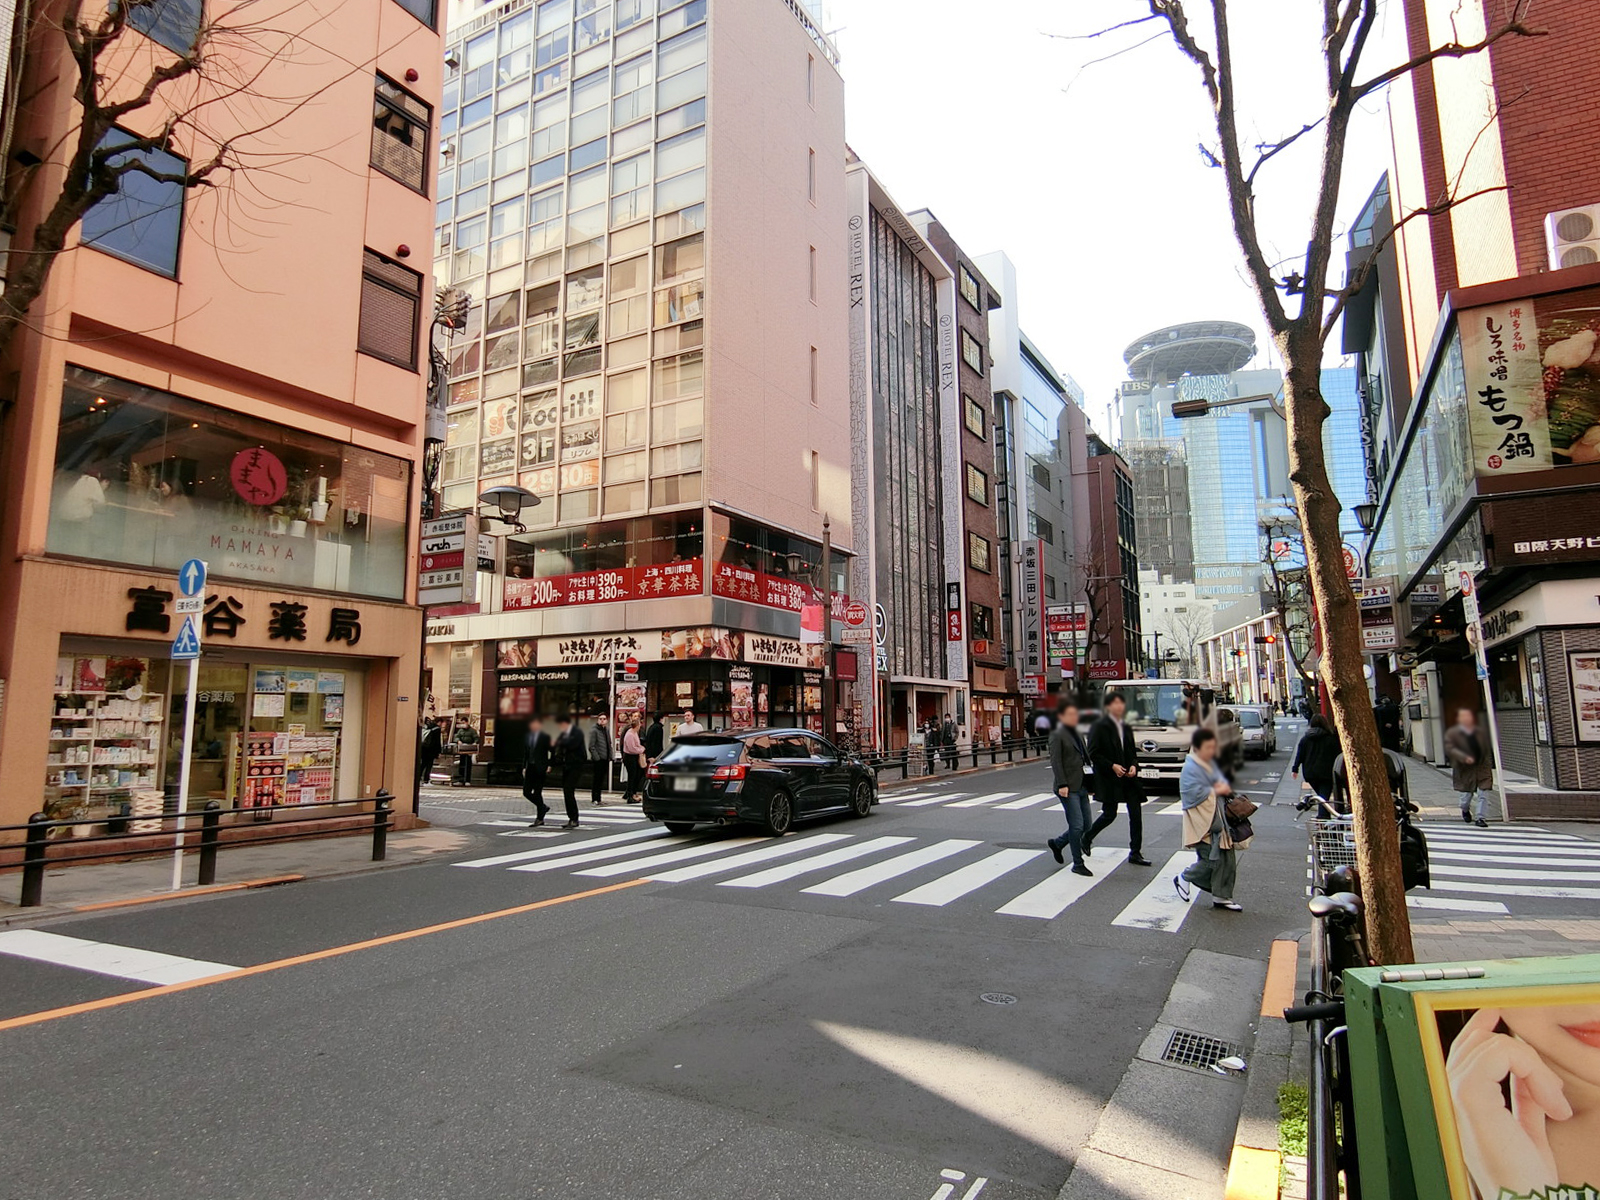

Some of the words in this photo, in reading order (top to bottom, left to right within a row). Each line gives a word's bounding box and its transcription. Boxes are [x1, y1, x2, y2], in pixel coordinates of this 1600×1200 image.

[853, 232, 862, 270] HOTEL
[905, 235, 927, 255] REX
[850, 273, 863, 309] REX
[1508, 307, 1526, 353] 博多名物
[944, 329, 952, 362] HOTEL
[941, 361, 953, 391] REX
[1124, 380, 1151, 392] TBS
[1358, 389, 1372, 459] FIRST
[1477, 385, 1536, 461] もつ鍋
[522, 436, 555, 461] 3F
[238, 449, 270, 500] ままや
[231, 525, 278, 539] DINING
[431, 520, 464, 533] 赤坂整体院
[210, 535, 294, 561] MAMAYA
[229, 561, 276, 574] AKASAKA
[644, 564, 693, 578] 上海・四川料理
[428, 572, 461, 584] 富谷薬局
[568, 588, 596, 603] お料理
[126, 585, 362, 646] 富谷薬局
[559, 638, 596, 655] いきなり
[603, 635, 637, 651] ステーキ
[751, 638, 777, 654] いきなり
[561, 654, 594, 663] IKINARI
[781, 655, 800, 665] STEAK
[876, 656, 888, 672] EX
[186, 690, 235, 704] 谷薬局
